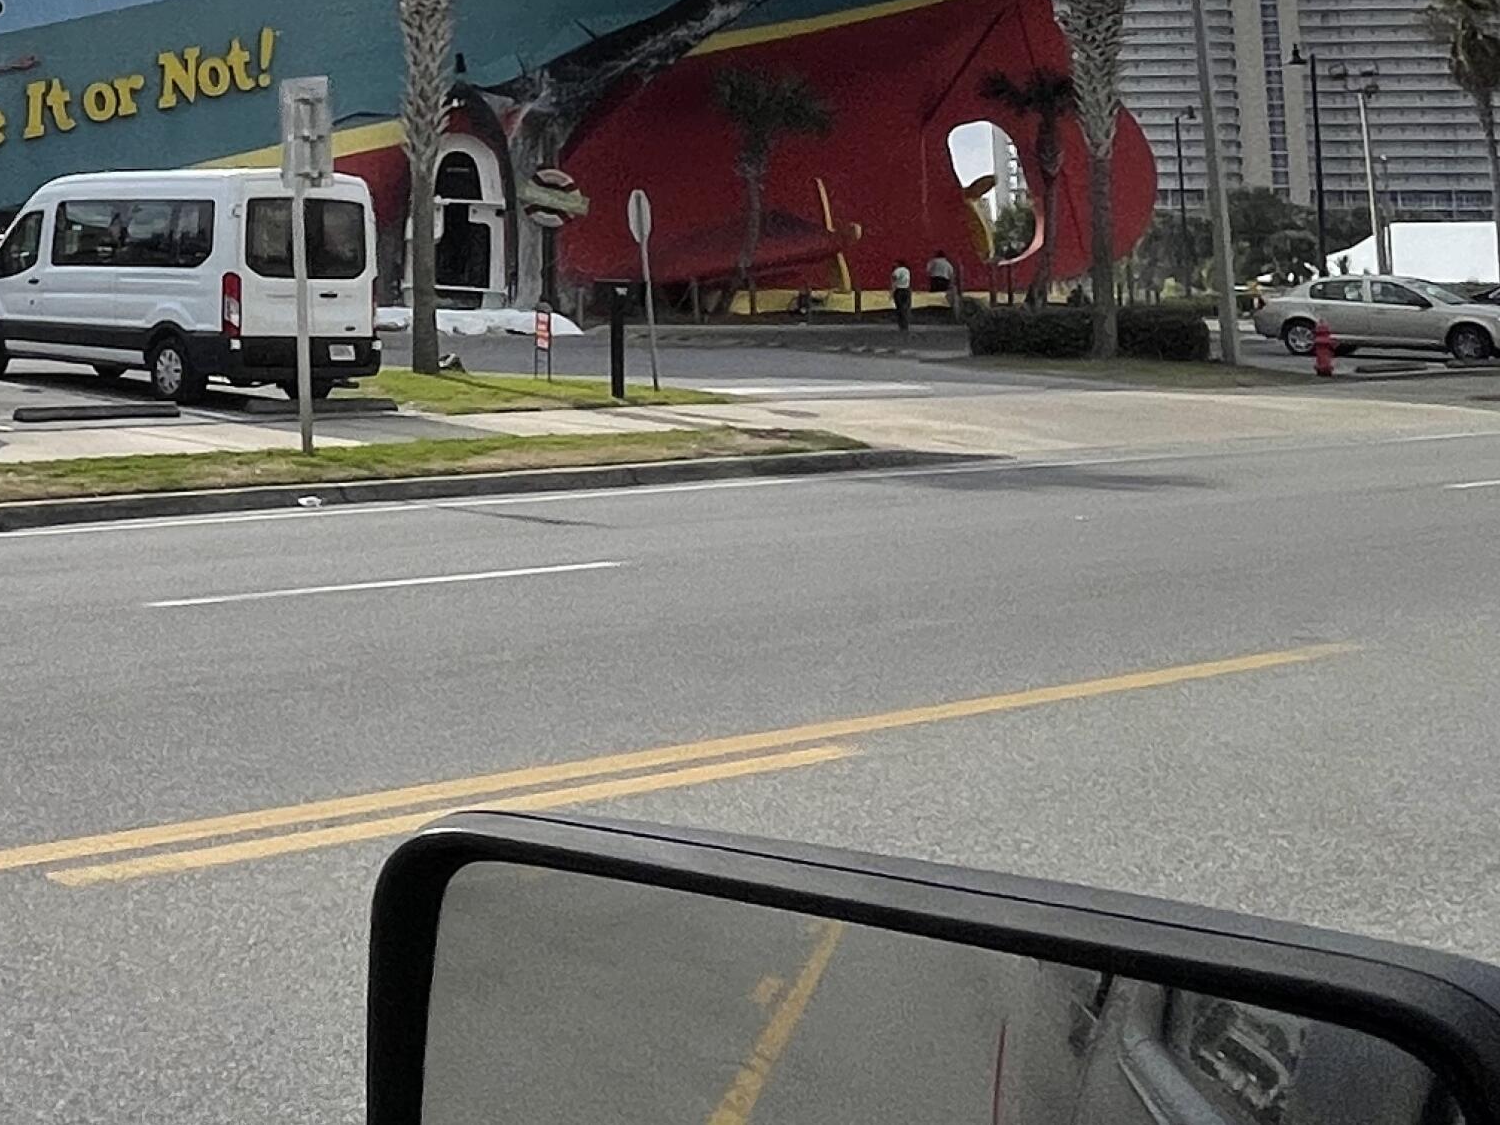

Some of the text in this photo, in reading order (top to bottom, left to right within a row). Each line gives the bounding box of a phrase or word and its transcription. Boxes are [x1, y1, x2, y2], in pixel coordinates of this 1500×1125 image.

[23, 77, 77, 140] It
[83, 74, 145, 122] or
[157, 26, 275, 109] Not!
